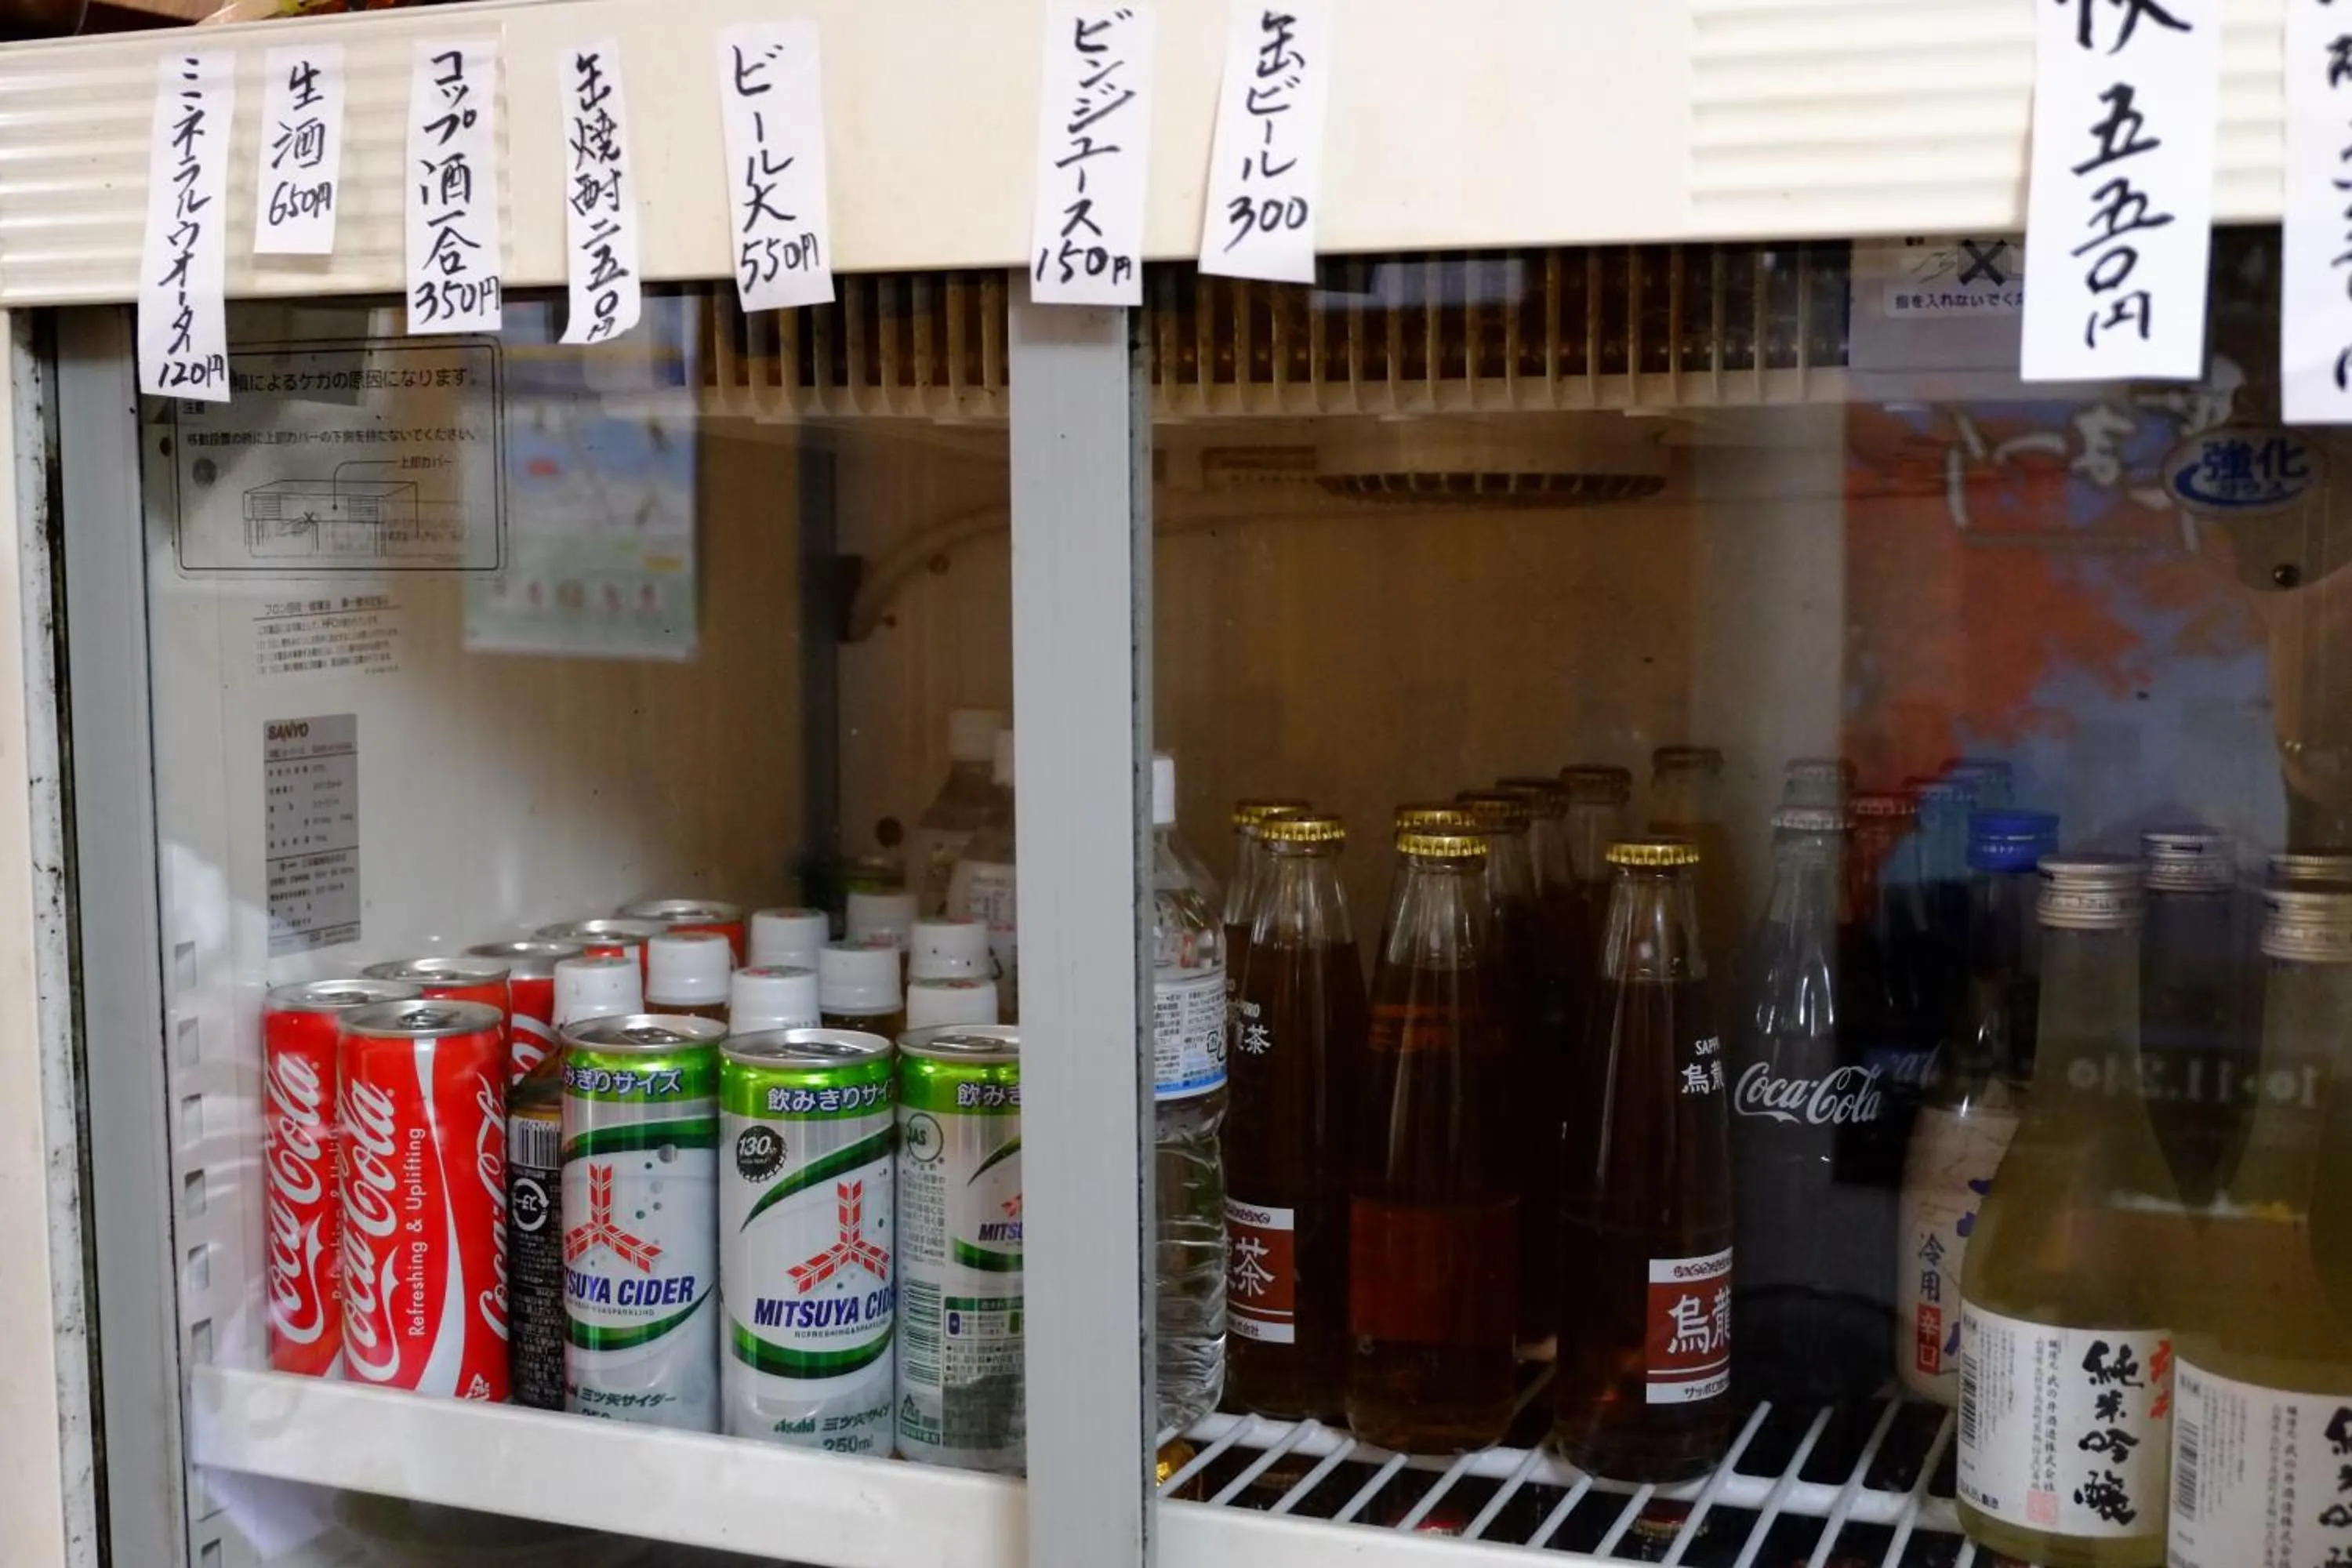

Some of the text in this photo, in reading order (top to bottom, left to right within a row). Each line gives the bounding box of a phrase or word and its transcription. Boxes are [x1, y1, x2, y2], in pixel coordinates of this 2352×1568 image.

[271, 60, 325, 169] 生酒
[1241, 10, 1305, 181] 缶ビール
[268, 181, 332, 226] 650円
[1223, 196, 1308, 253] 300
[740, 232, 819, 294] 550円
[1036, 239, 1131, 285] 150円
[415, 275, 500, 324] 350円
[158, 354, 225, 388] 120円
[2201, 437, 2311, 482] 強化
[267, 721, 309, 741] SANYO
[1733, 1061, 1883, 1125] Coca-Cola
[739, 1135, 771, 1156] 130
[343, 1077, 401, 1382] Coca-Cola
[404, 1127, 426, 1338] Refreshing & Uplifting
[617, 1275, 695, 1307] CIDER
[753, 1296, 859, 1330] MITSUYA
